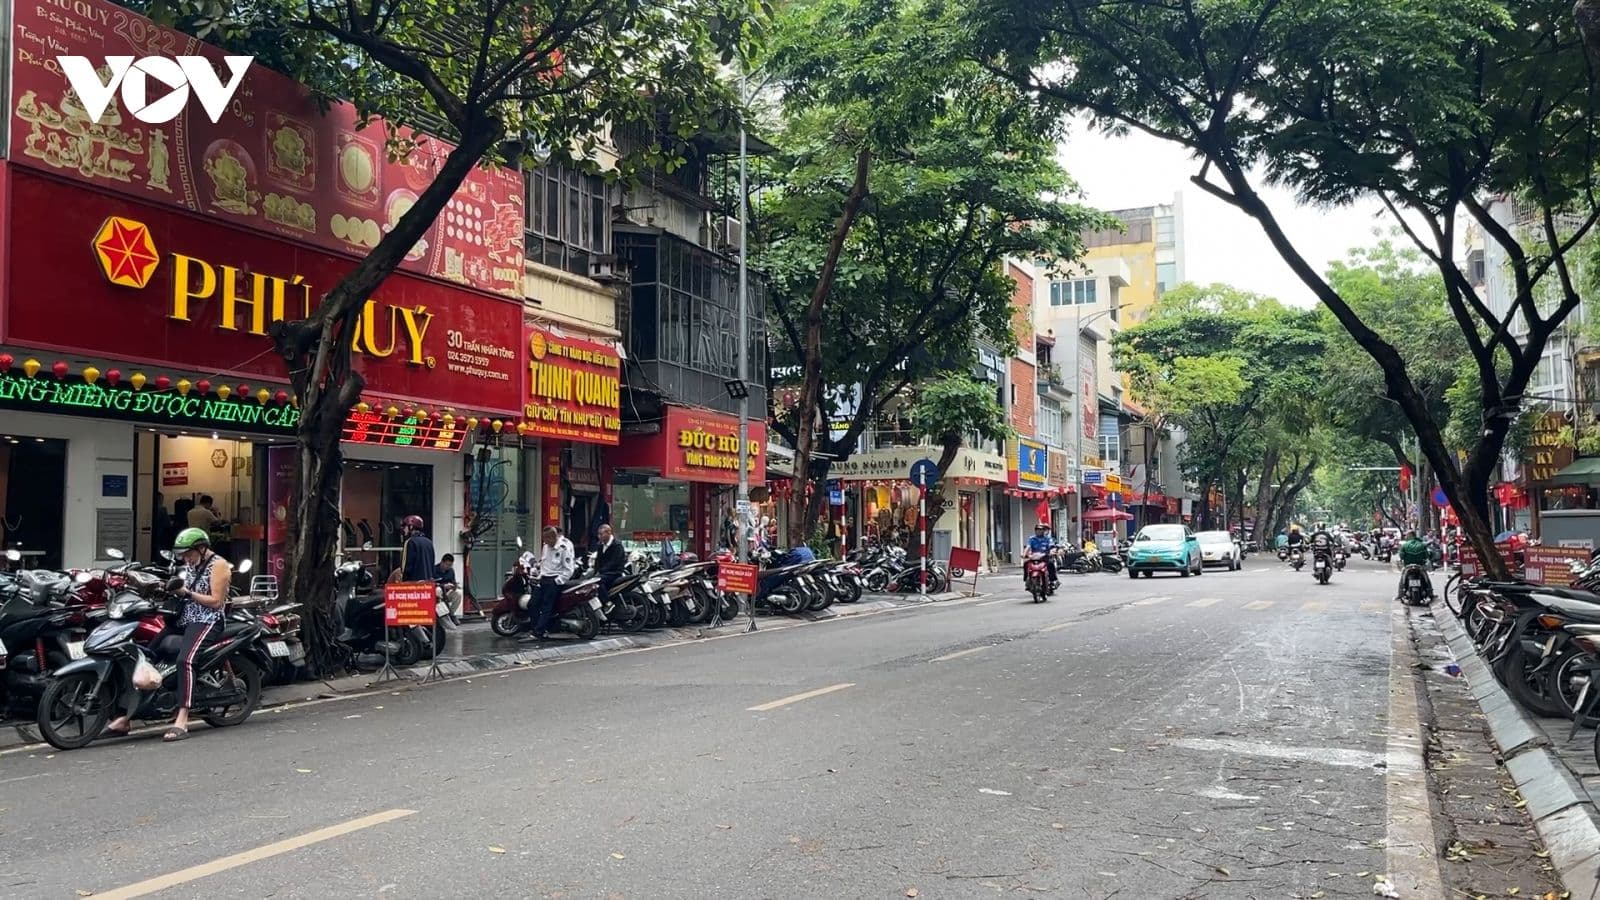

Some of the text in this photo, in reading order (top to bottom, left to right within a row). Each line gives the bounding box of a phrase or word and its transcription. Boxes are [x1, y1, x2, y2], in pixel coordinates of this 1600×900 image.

[113, 11, 176, 53] 2022
[166, 253, 434, 364] PHÚ UÝ
[447, 329, 463, 349] 30
[499, 346, 515, 359] TÔNG
[529, 360, 620, 409] THỊNH QUANG
[132, 391, 199, 418] ĐƯỢC
[200, 400, 264, 424] NHNN
[604, 415, 621, 430] VÀNG
[679, 426, 760, 456] ĐỨC HÙG
[686, 449, 702, 466] VÀNG
